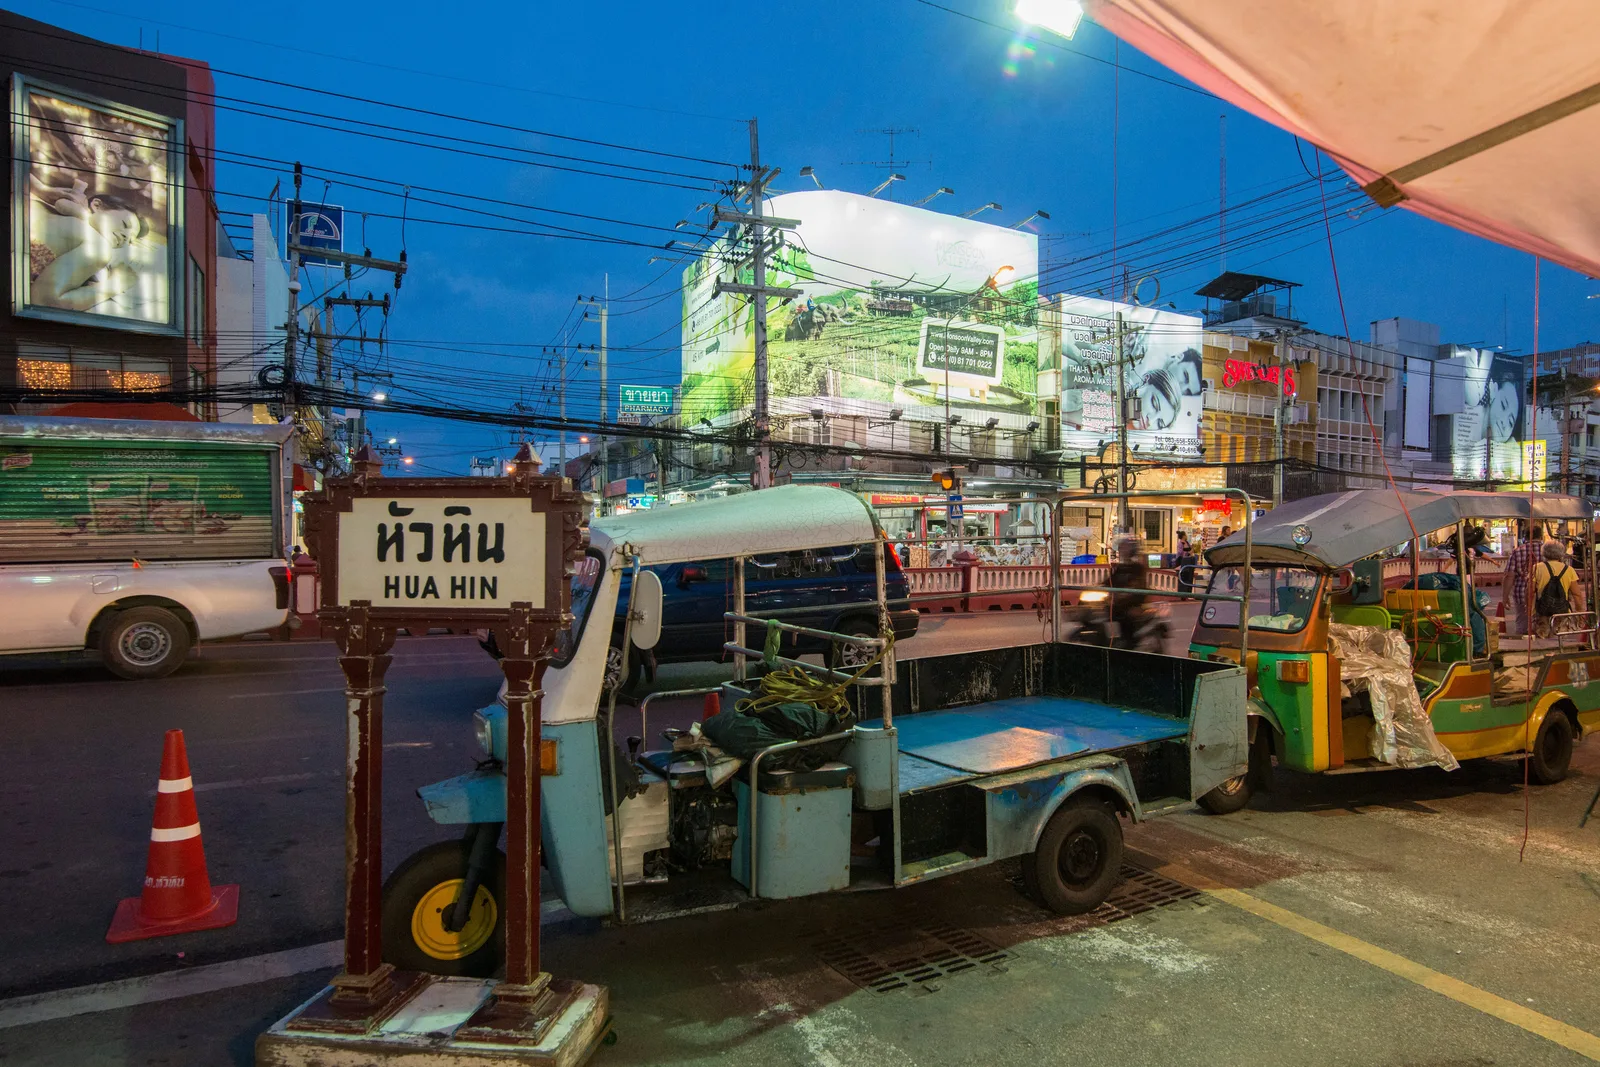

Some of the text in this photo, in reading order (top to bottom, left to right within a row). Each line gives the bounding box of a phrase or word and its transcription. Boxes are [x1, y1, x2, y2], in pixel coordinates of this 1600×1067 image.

[928, 342, 944, 352] Open
[946, 344, 960, 355] Daily
[960, 346, 975, 356] 9AM
[979, 349, 994, 359] 8PM
[948, 355, 957, 364] (0)
[957, 357, 965, 365] 81
[965, 358, 976, 367] 701
[977, 360, 993, 369] 0222
[1073, 375, 1096, 385] AROMA
[625, 389, 669, 403] ขายยา
[624, 404, 670, 412] PHARMACY
[376, 500, 506, 564] หัวหิน
[384, 575, 498, 600] HUA HIN
